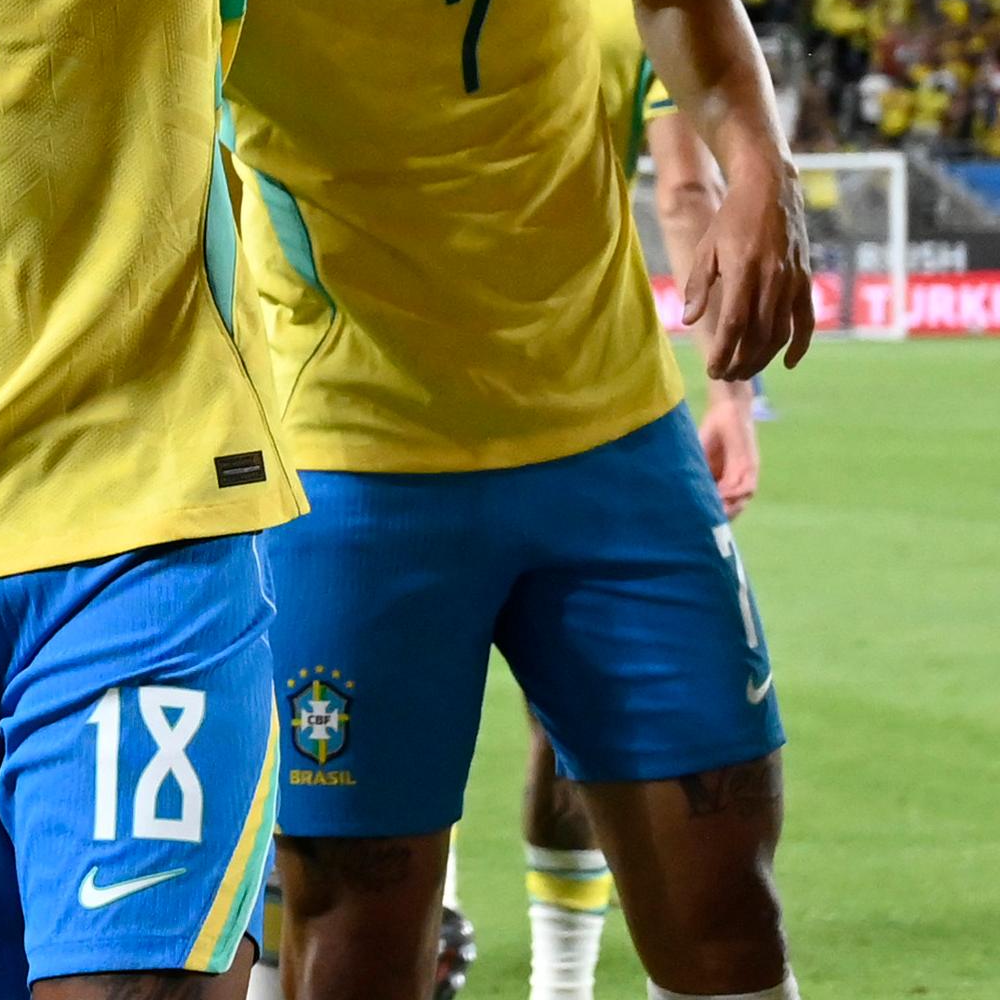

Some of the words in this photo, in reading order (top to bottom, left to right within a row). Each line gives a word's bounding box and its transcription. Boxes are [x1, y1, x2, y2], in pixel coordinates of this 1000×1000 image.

[307, 714, 331, 725] CBF
[84, 687, 206, 843] 18
[290, 769, 357, 785] BRASIL
